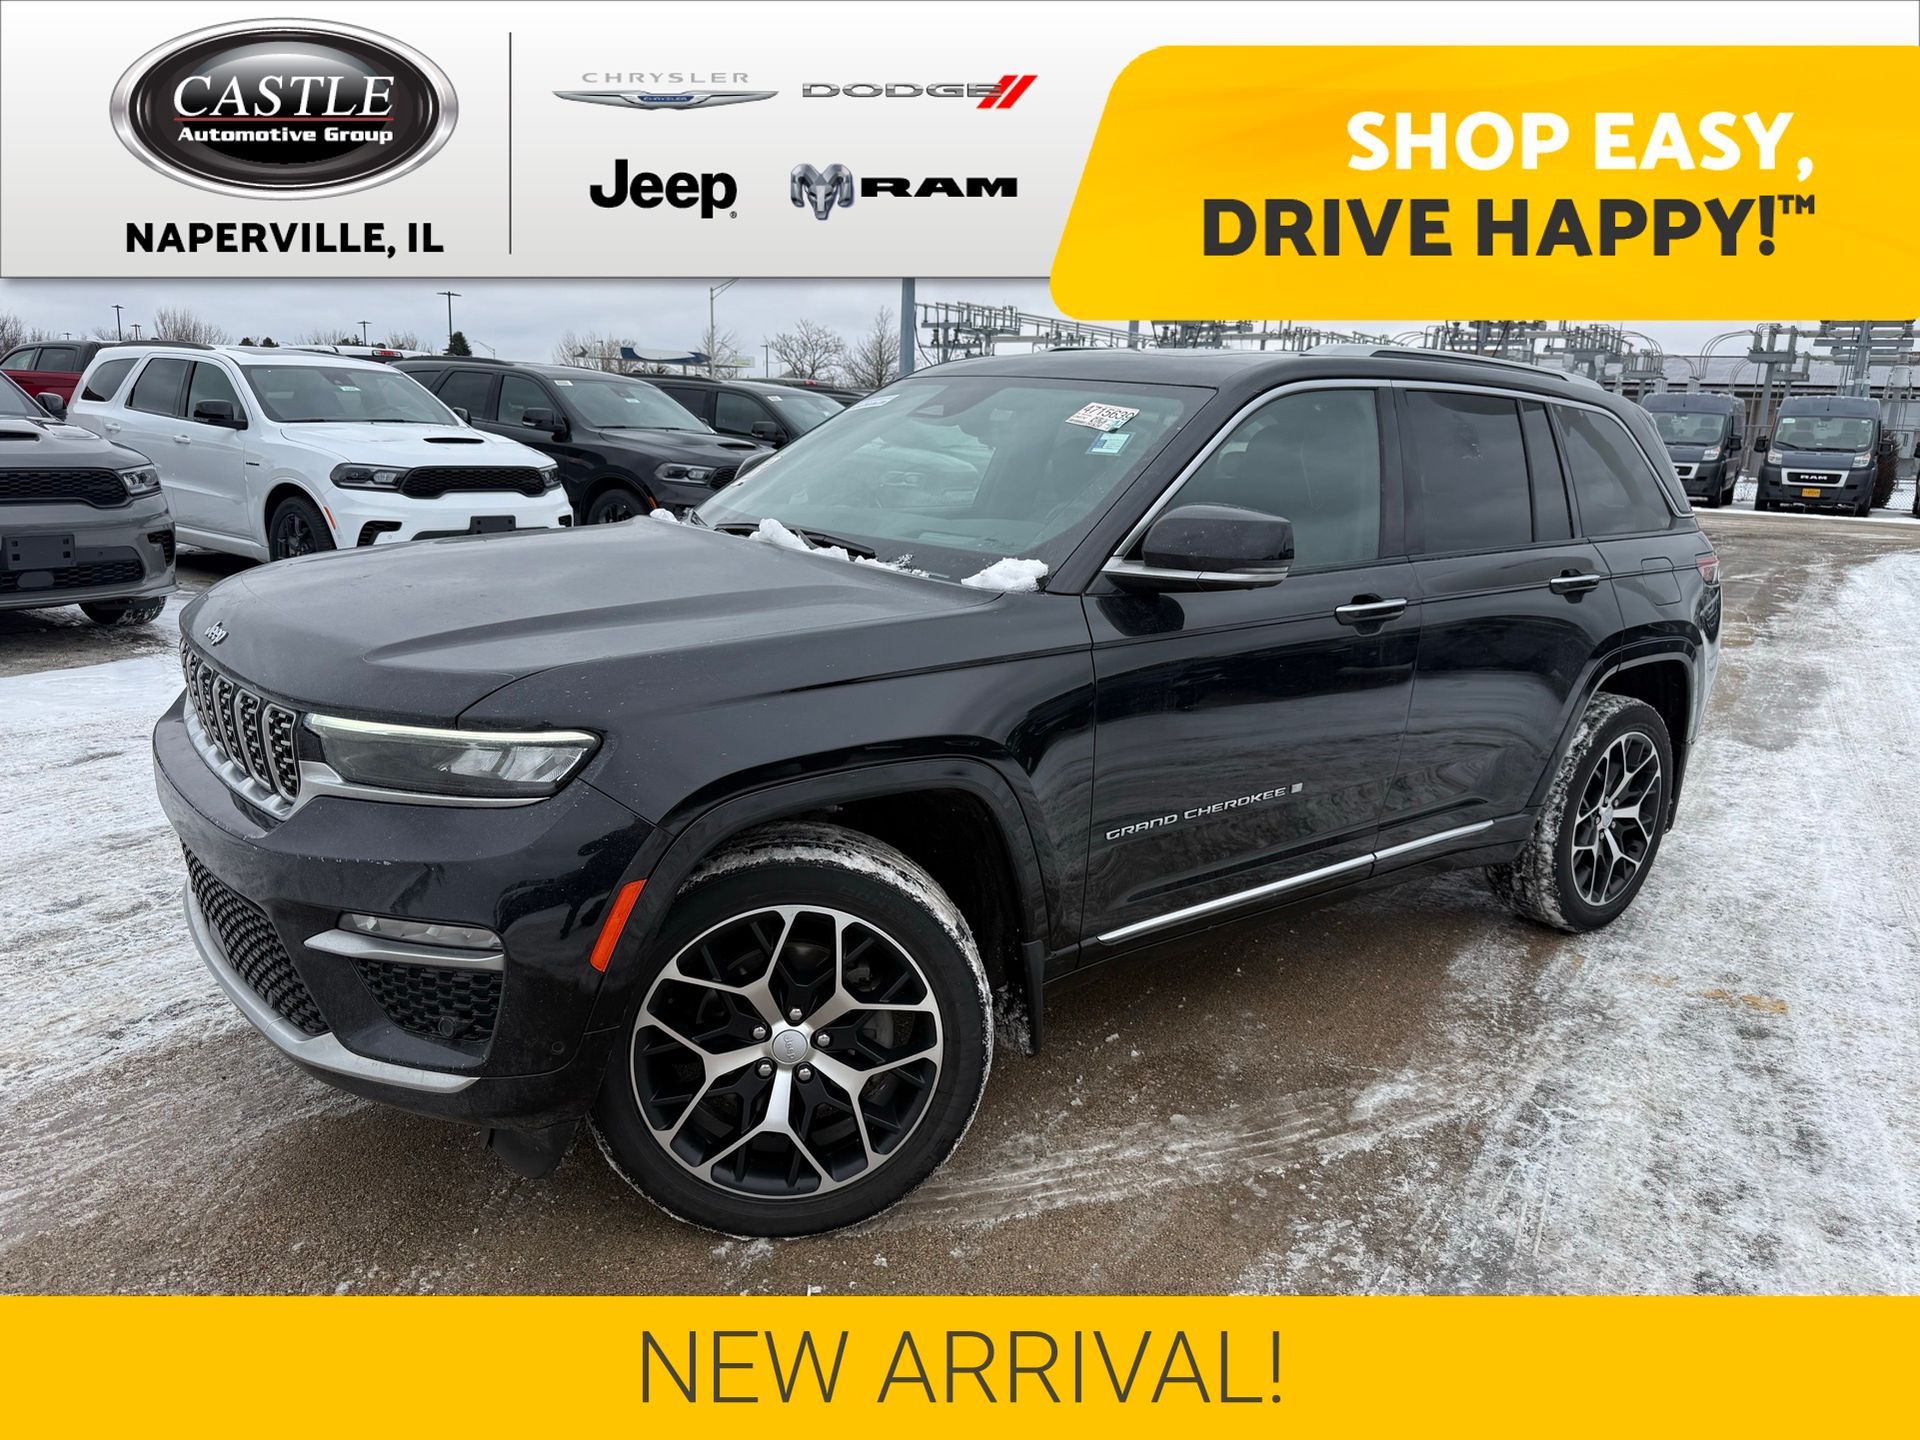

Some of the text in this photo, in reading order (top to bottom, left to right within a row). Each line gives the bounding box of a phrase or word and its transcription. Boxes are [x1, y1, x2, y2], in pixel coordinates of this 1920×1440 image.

[204, 620, 229, 647] Jeep
[1105, 786, 1287, 841] GRAND CHEROKEE
